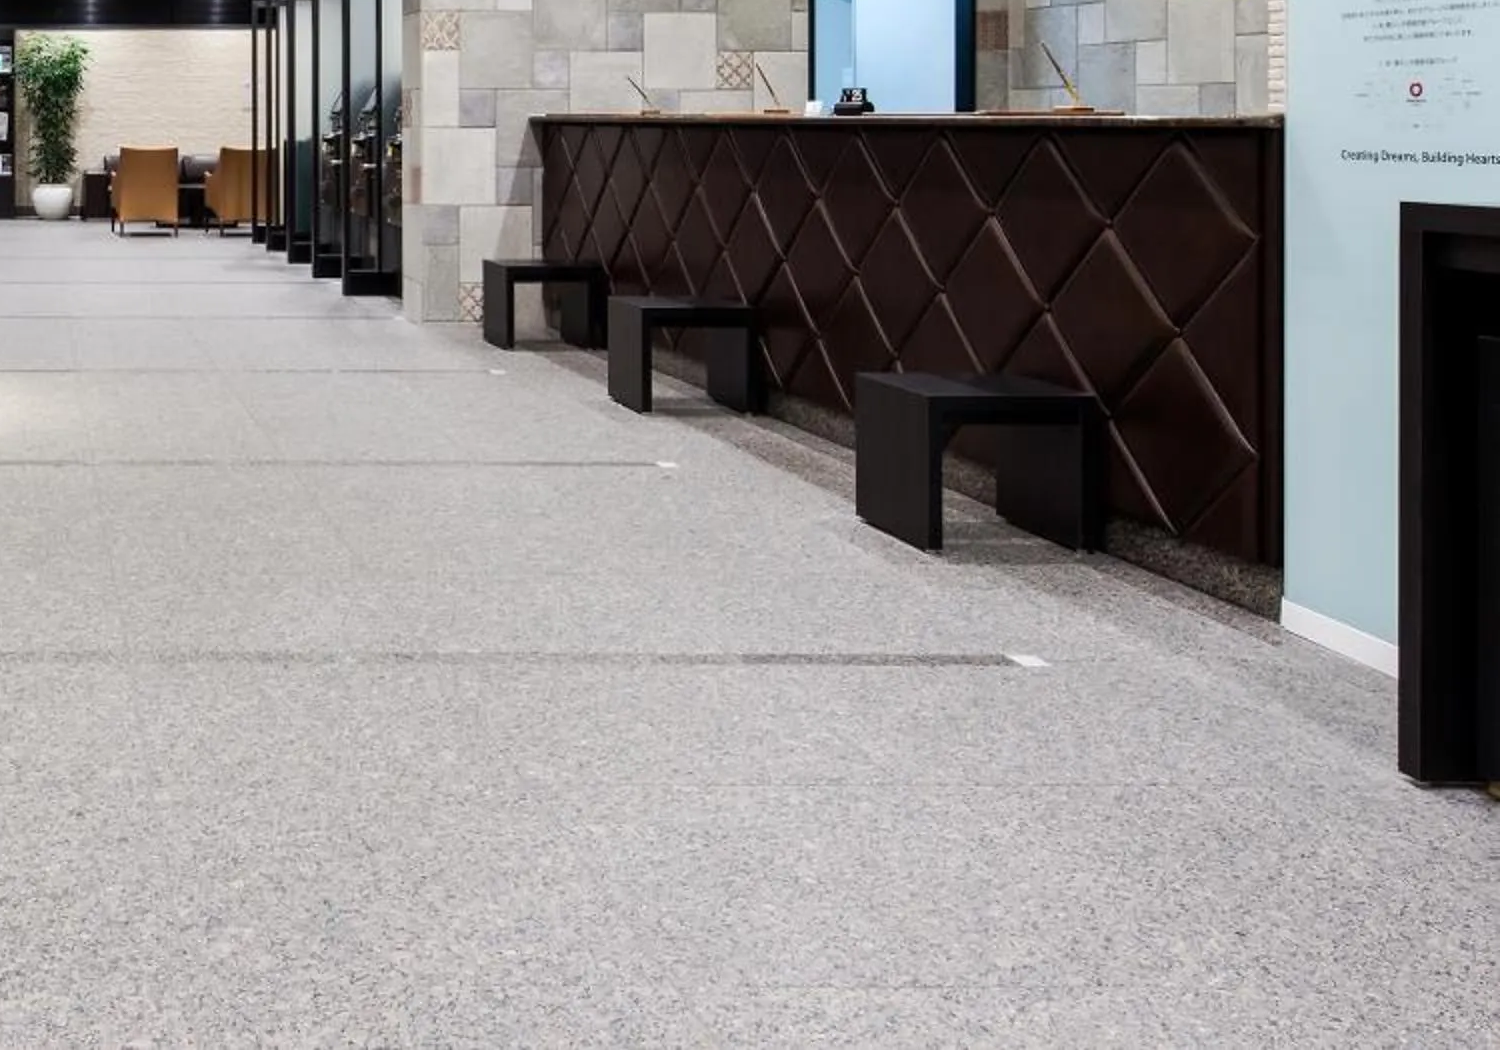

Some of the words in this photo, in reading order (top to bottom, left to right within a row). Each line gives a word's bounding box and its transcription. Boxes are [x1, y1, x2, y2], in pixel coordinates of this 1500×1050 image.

[1340, 149, 1378, 163] Creating
[1422, 151, 1463, 166] Building
[1465, 153, 1500, 165] Hearts
